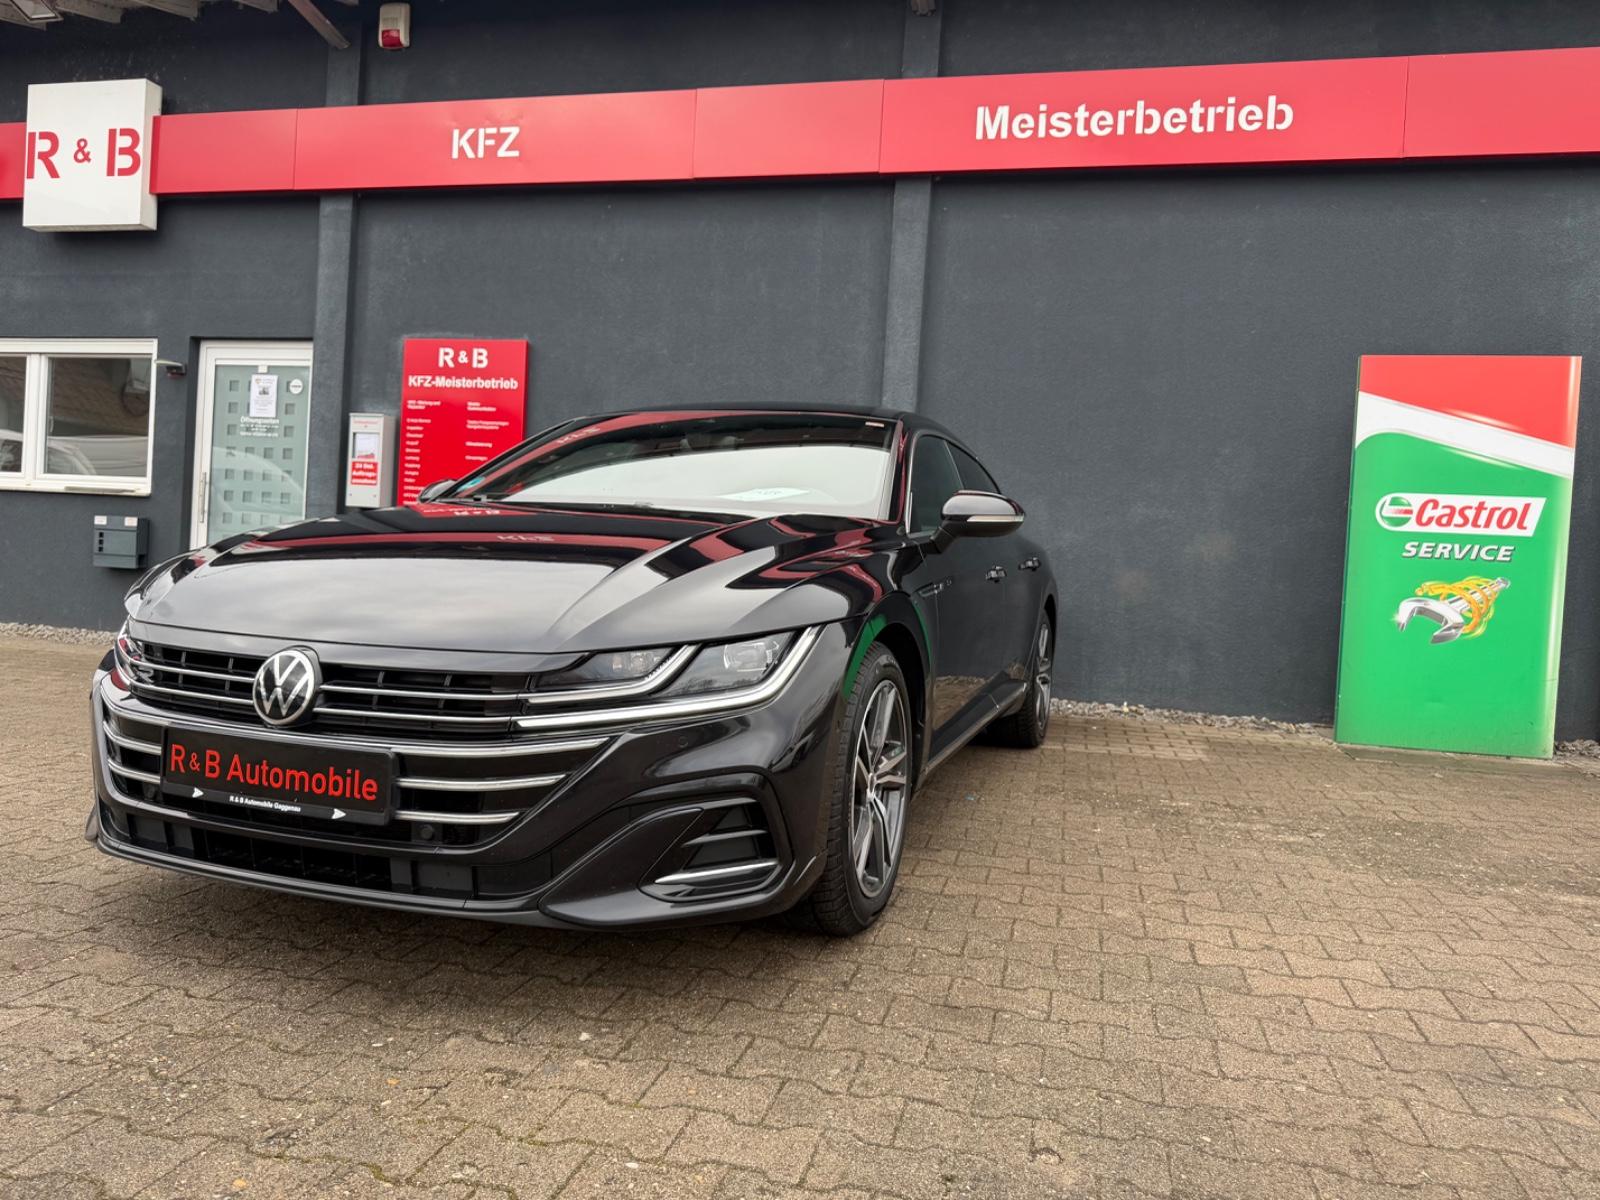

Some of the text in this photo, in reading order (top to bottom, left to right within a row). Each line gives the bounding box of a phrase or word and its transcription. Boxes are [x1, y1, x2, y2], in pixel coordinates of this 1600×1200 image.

[974, 95, 1295, 140] Meisterbetrieb
[26, 128, 141, 179] R & B
[451, 126, 521, 160] KFZ
[438, 347, 488, 368] R & B
[408, 375, 518, 390] KFZ-Meisterbetrieb
[1415, 498, 1532, 530] Castrol
[1401, 541, 1515, 562] SERVICE
[170, 744, 378, 801] R & B Automobile
